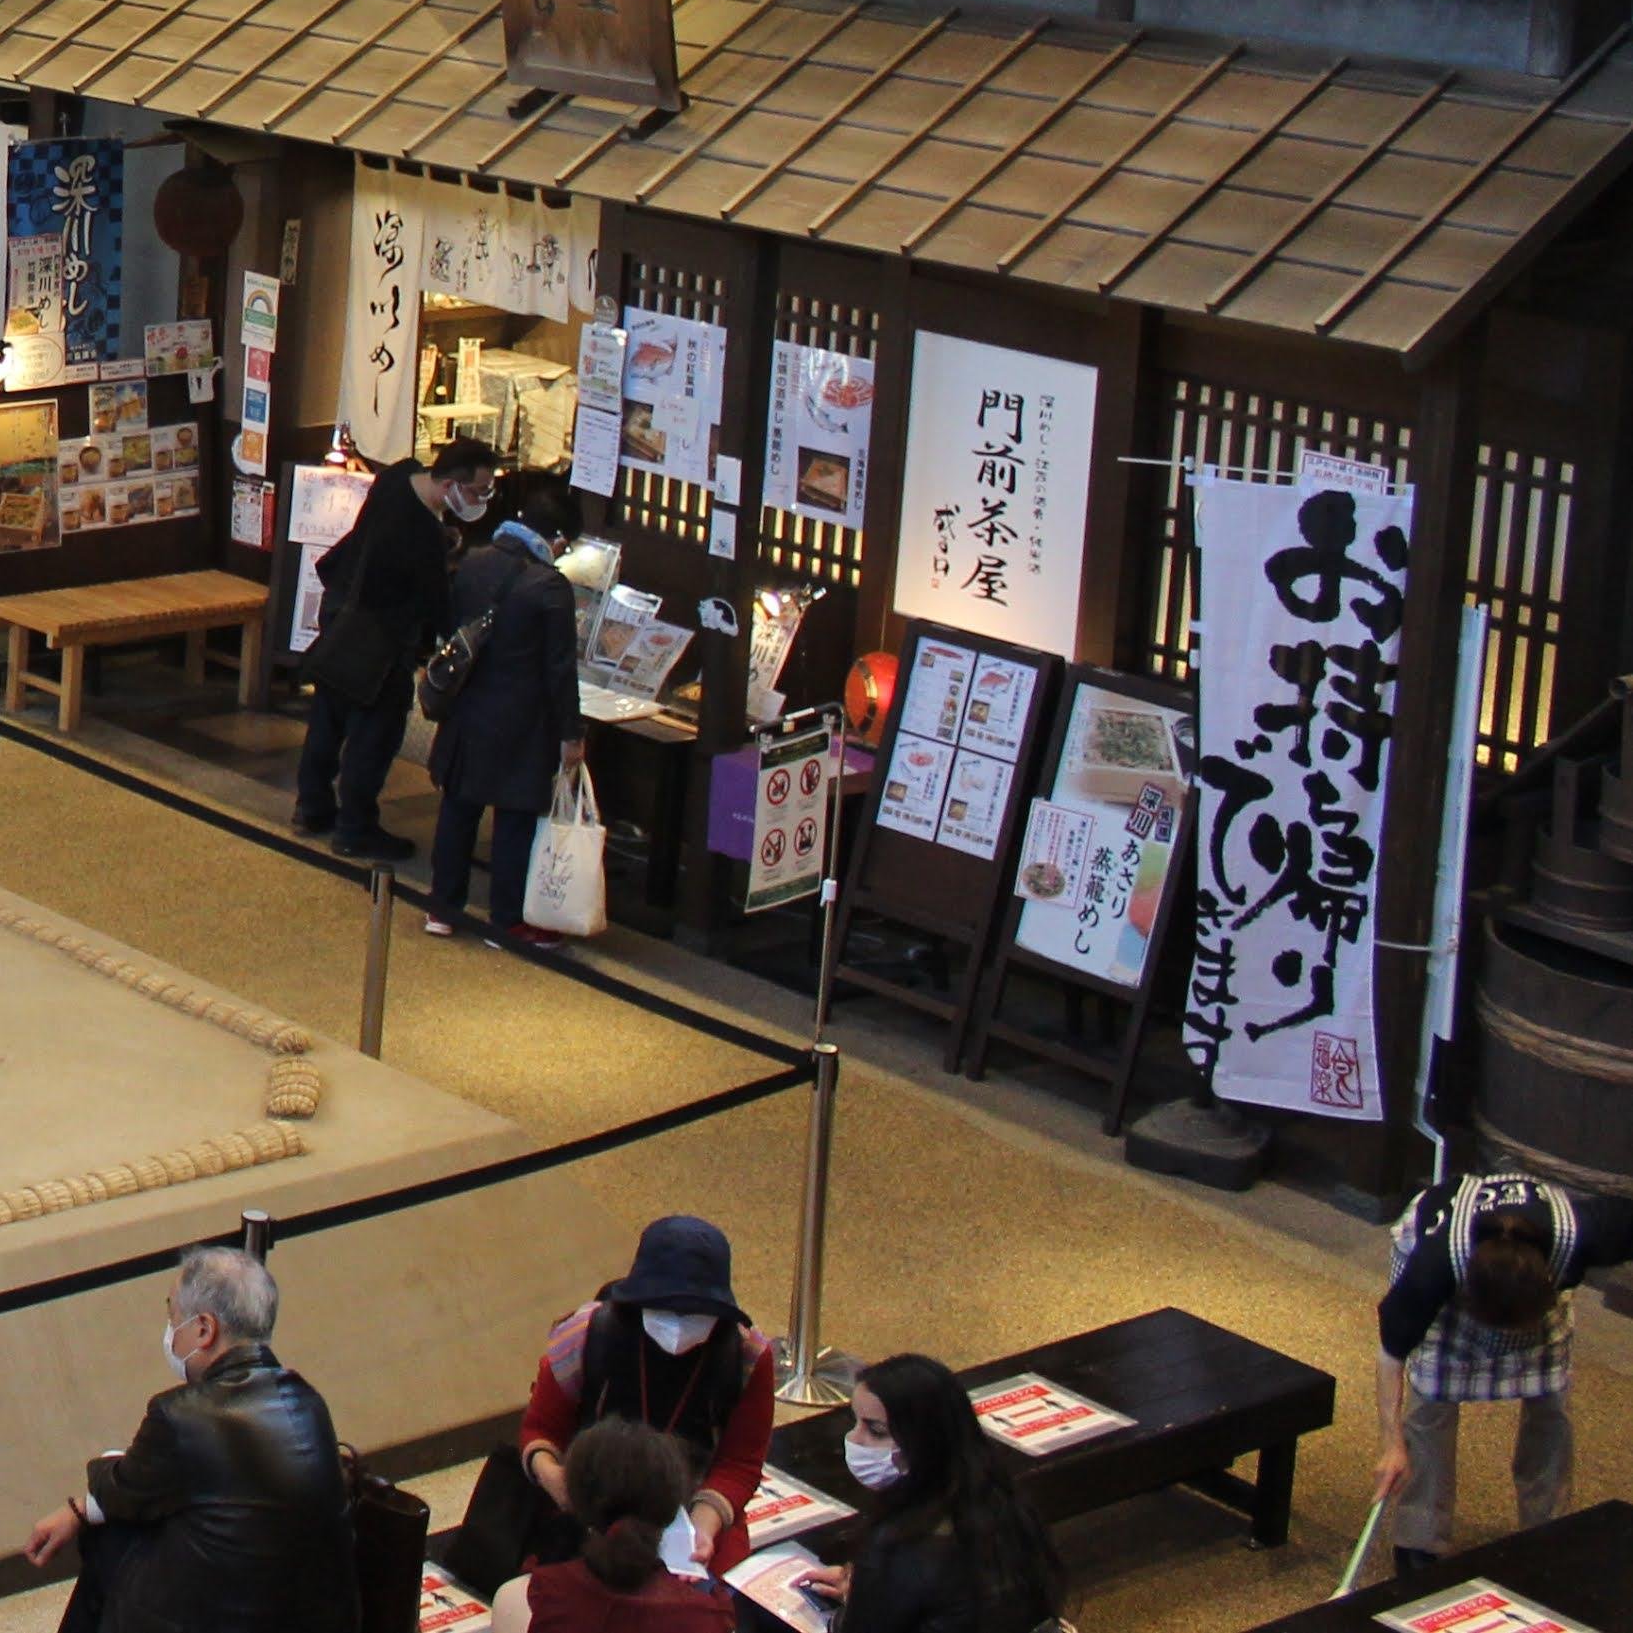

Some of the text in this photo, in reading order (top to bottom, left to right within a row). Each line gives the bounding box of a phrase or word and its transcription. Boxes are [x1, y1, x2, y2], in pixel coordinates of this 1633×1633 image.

[38, 256, 53, 330] 深川めし
[52, 154, 98, 316] 深川めし
[370, 210, 404, 419] 深川めし
[960, 389, 1026, 608] 門前茶屋
[1232, 490, 1408, 1043] お持ち帰り
[1111, 839, 1141, 919] あさり
[1184, 734, 1275, 1082] できます
